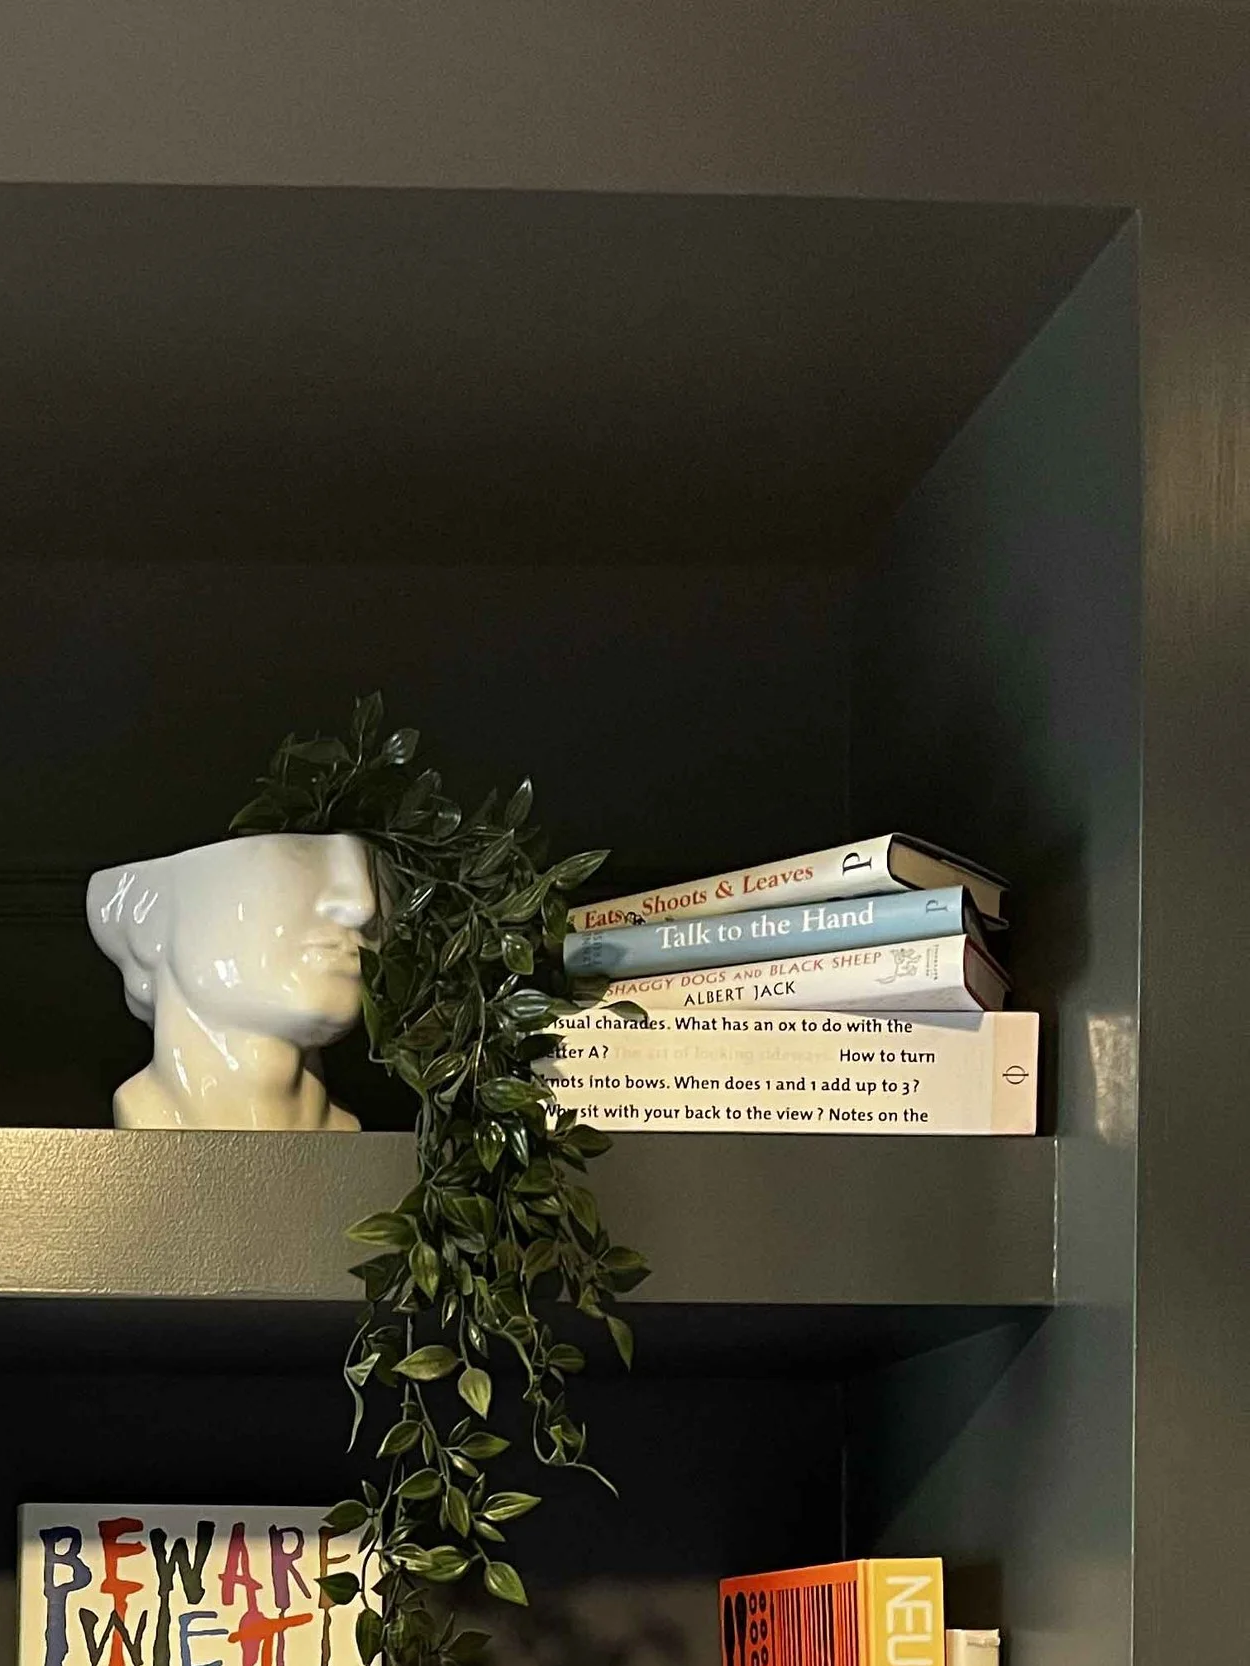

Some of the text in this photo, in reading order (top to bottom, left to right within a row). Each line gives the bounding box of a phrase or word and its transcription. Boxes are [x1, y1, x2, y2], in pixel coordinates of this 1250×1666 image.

[641, 884, 708, 918] Shoots
[715, 880, 735, 899] &
[741, 866, 815, 895] Leaves
[655, 901, 875, 951] Talk to the Hand
[606, 951, 884, 999] SHAGGY DOGS AND BLACK SHEEP
[684, 981, 796, 1008] ALBERT JACK
[551, 1015, 913, 1033] isual charades. What has an ox to do with the
[548, 1045, 585, 1059] tter
[839, 1049, 935, 1064] How to turn
[589, 1075, 621, 1089] into
[625, 1075, 670, 1090] bows.
[674, 1076, 720, 1090] When
[724, 1076, 761, 1091] does
[766, 1080, 772, 1091] 1
[776, 1077, 806, 1092] and
[810, 1080, 817, 1091] 1
[821, 1078, 851, 1092] add
[855, 1080, 877, 1095] up
[881, 1079, 898, 1092] to
[580, 1104, 599, 1119] sit
[604, 1104, 639, 1119] with
[643, 1106, 681, 1123] your
[685, 1105, 722, 1120] back
[726, 1106, 743, 1120] to
[747, 1106, 772, 1121] the
[829, 1108, 874, 1122] Notes
[878, 1110, 898, 1122] on
[903, 1108, 929, 1123] the
[39, 1517, 352, 1606] BEWARE
